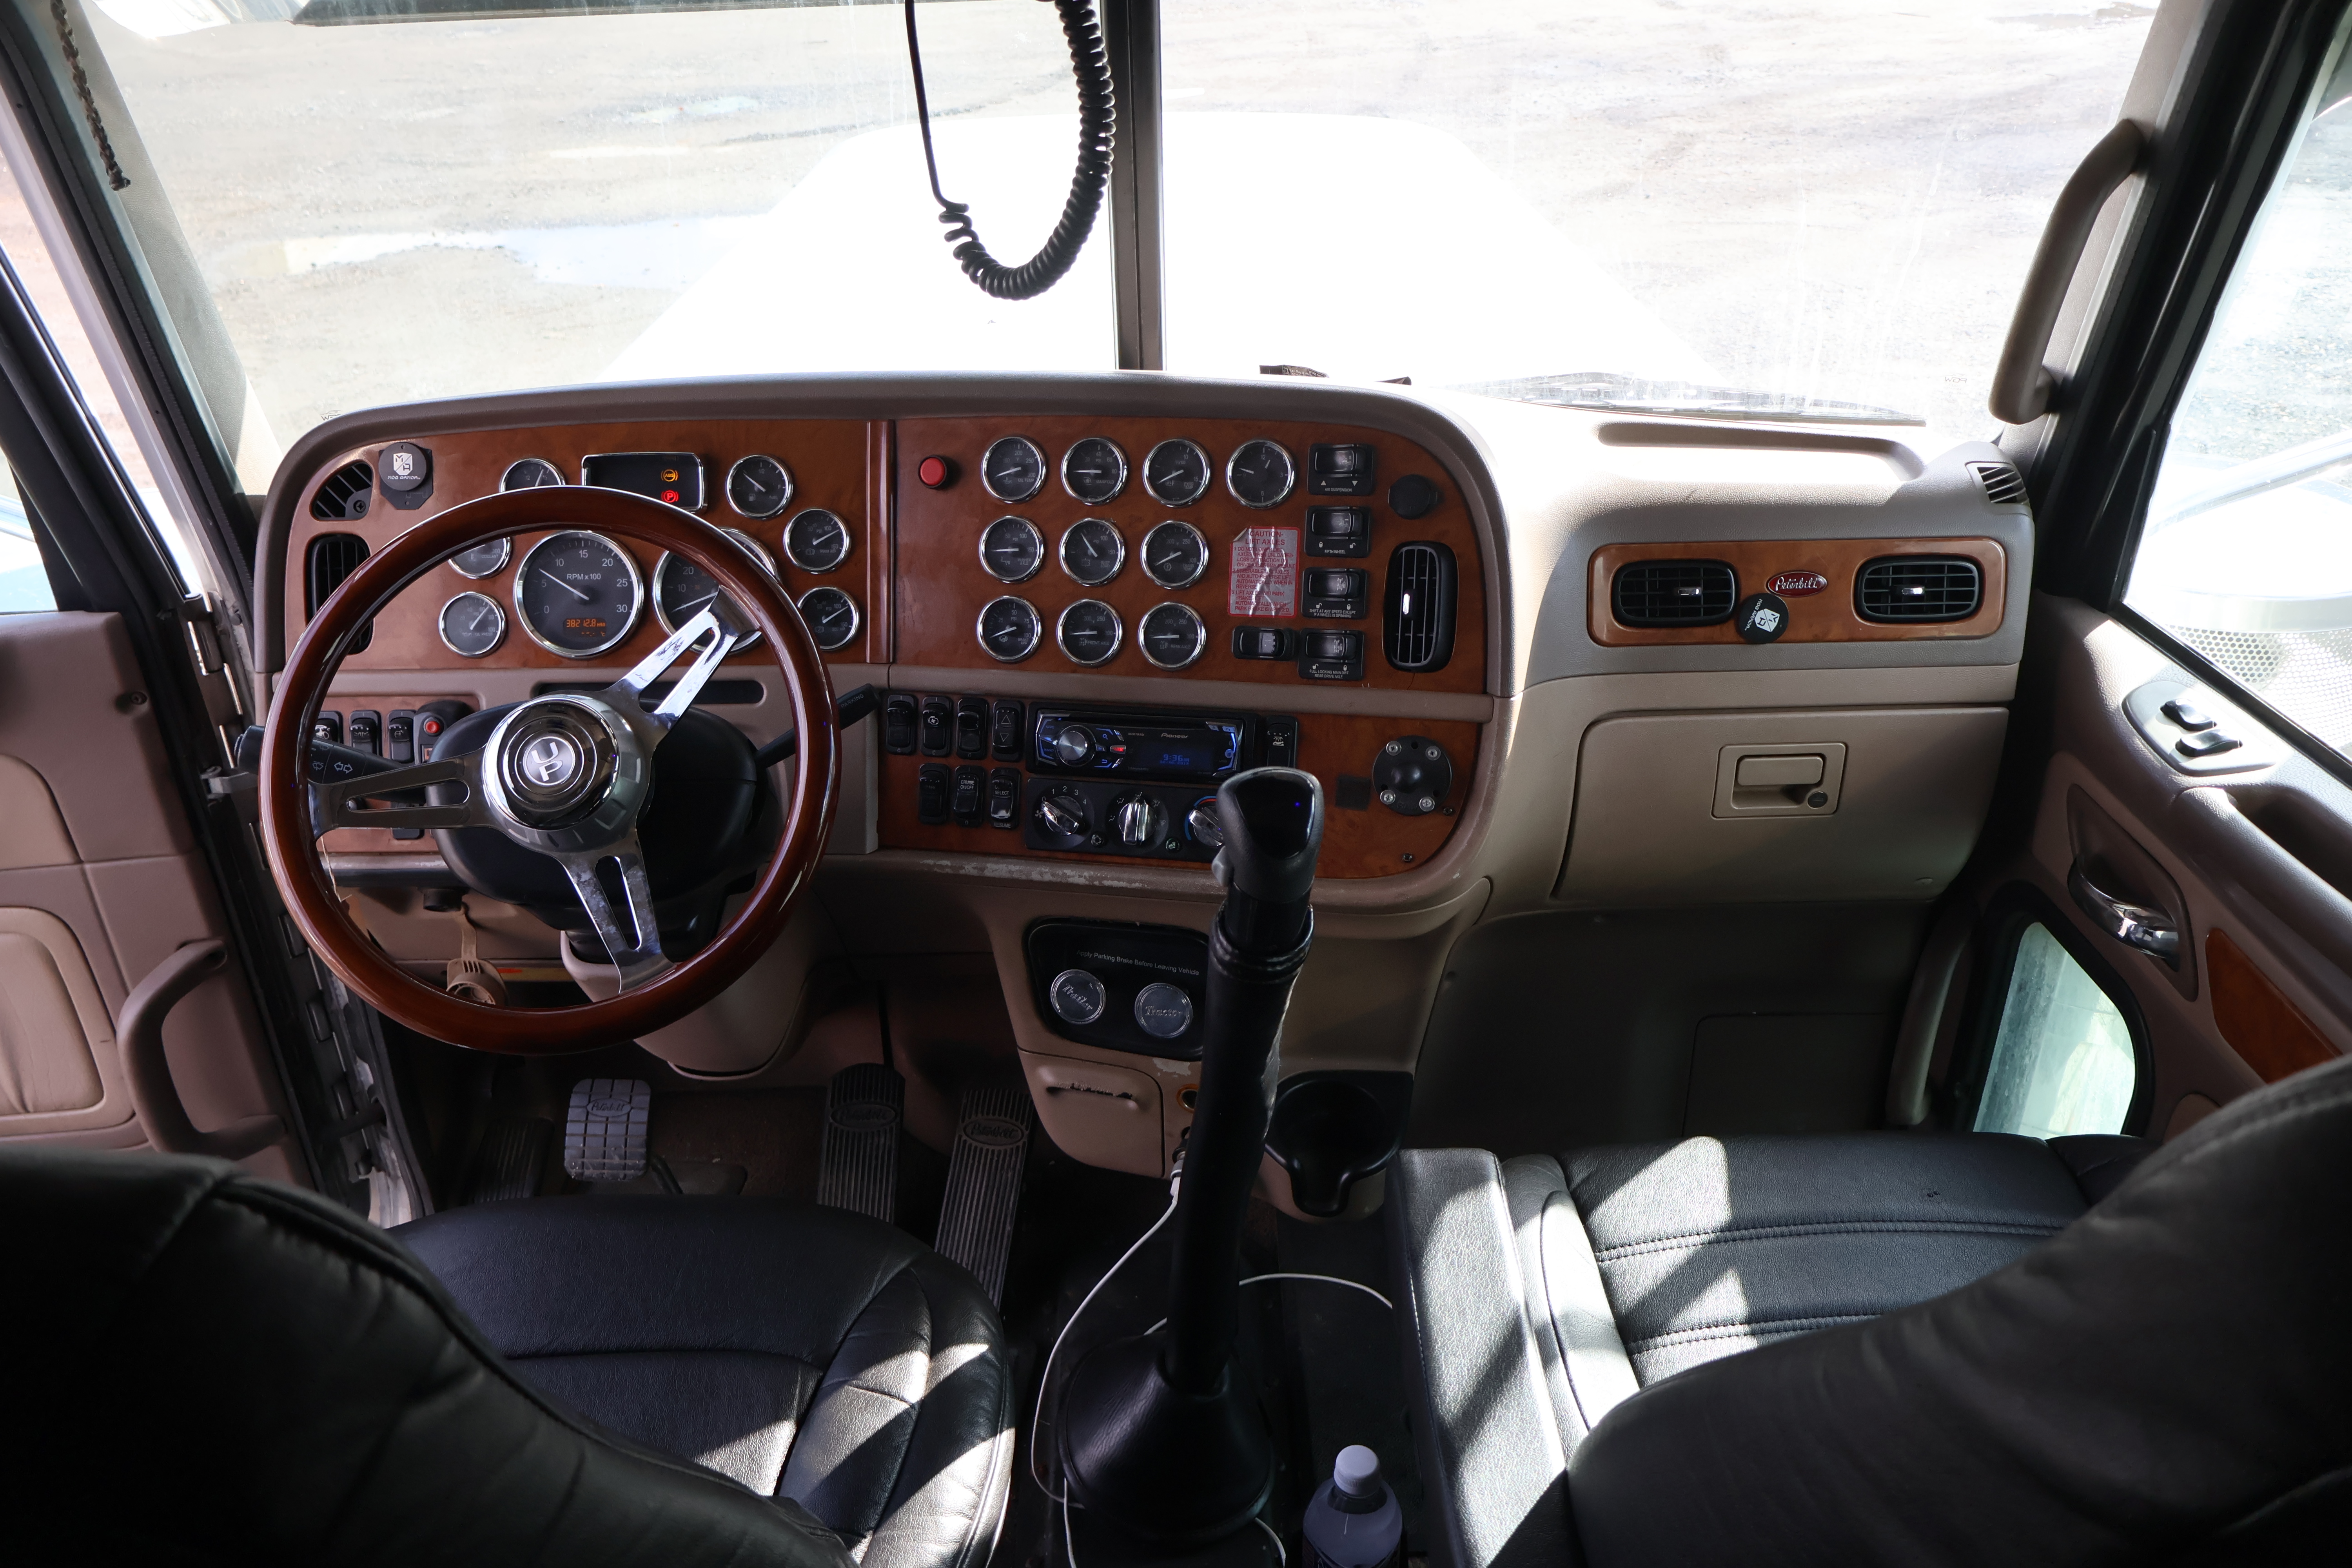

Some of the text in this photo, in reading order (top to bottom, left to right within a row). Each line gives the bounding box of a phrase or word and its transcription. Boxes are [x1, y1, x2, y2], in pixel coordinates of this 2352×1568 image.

[579, 550, 588, 558] 15
[556, 559, 564, 567] 10
[602, 558, 613, 567] 20
[682, 566, 694, 575] 20
[616, 579, 628, 587] 25
[1775, 577, 1818, 591] Peterbilt
[678, 584, 686, 592] 10
[544, 606, 550, 614] 0
[616, 604, 628, 613] 30
[1163, 753, 1183, 762] 9:36
[1094, 952, 1115, 962] Parking
[1116, 956, 1133, 964] Brake
[1134, 958, 1153, 968] Before
[1154, 961, 1177, 973] Leaving
[1178, 964, 1199, 976] Vehicle
[1062, 983, 1093, 1011] Trailer
[1145, 1005, 1183, 1017] Tractor
